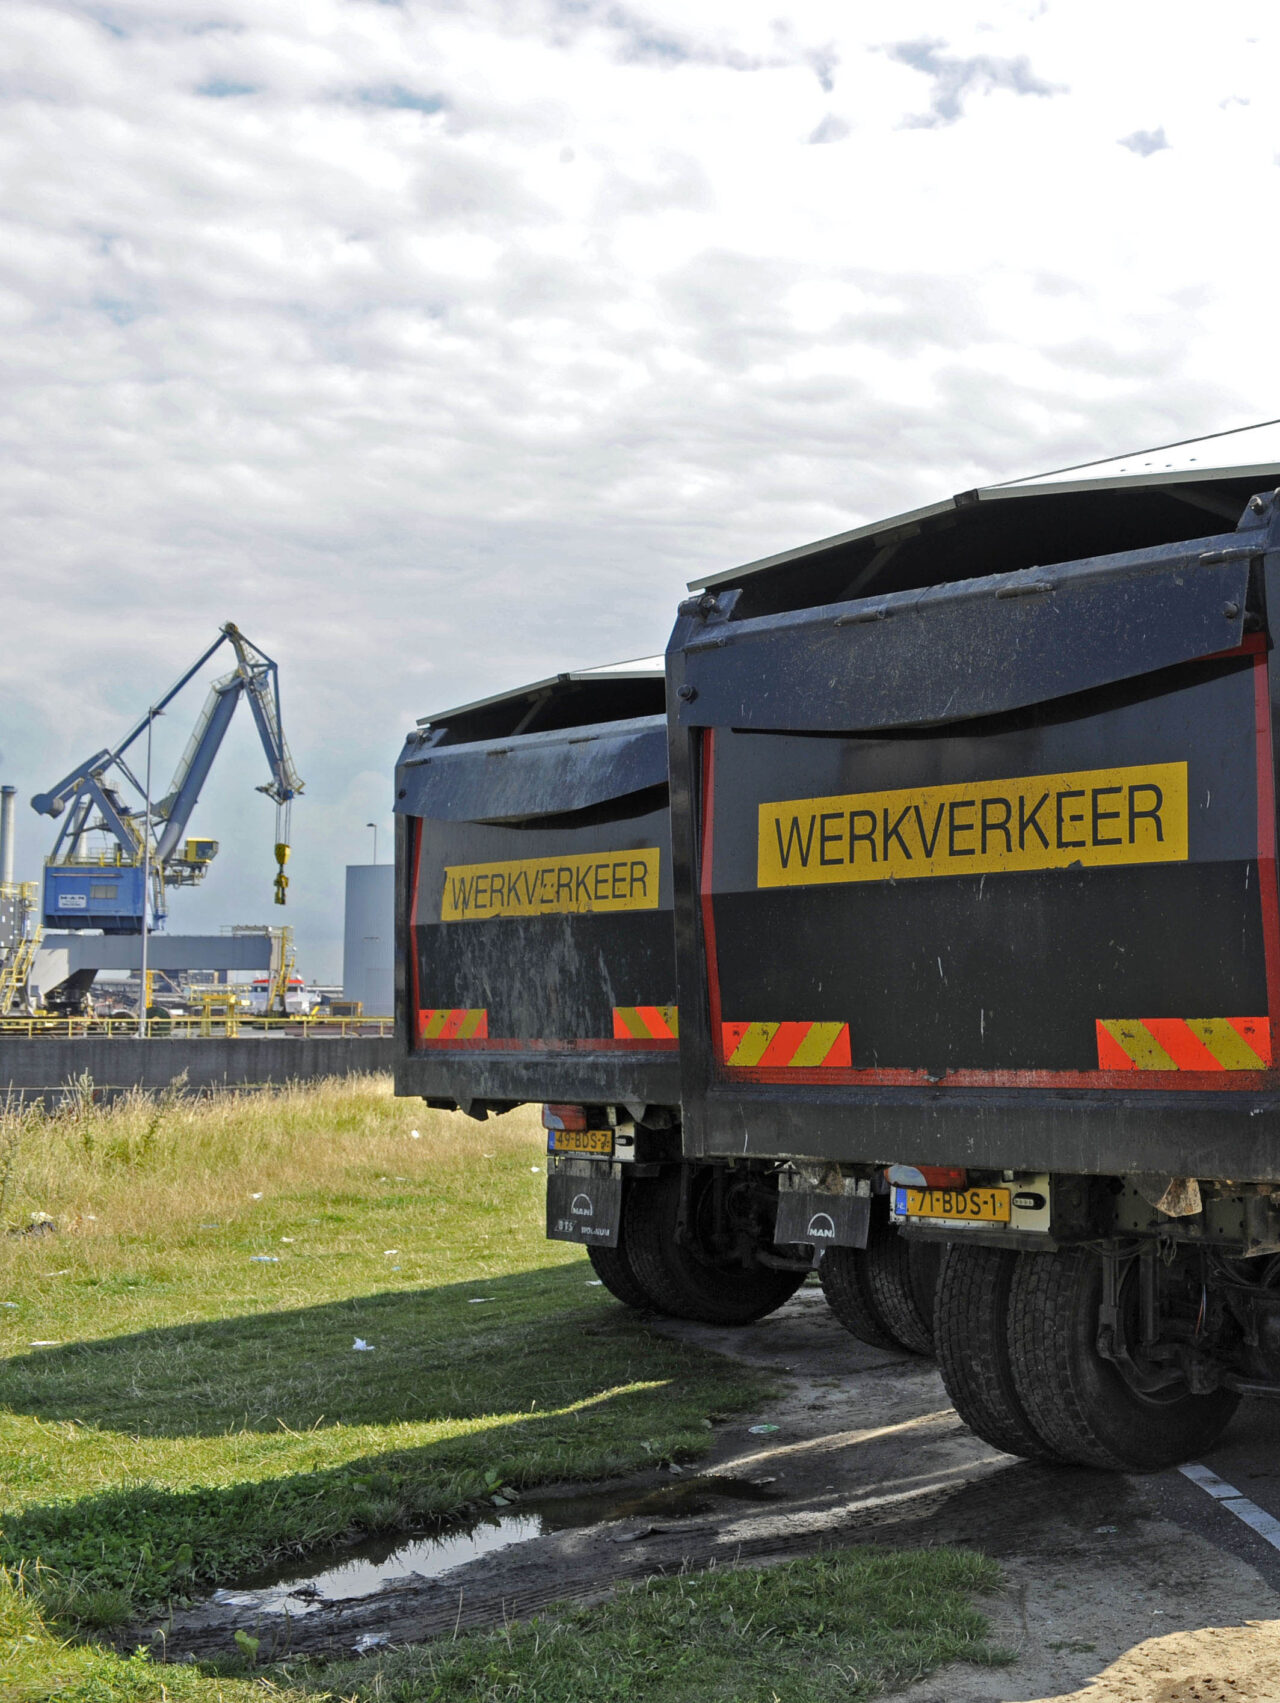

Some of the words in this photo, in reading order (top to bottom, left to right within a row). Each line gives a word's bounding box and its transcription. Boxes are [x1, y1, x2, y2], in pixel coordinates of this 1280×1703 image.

[775, 784, 1165, 869] WERKVERKEER
[452, 860, 648, 911] WERKVERKEER
[918, 1187, 997, 1216] 71-BDS-1
[809, 1228, 833, 1238] MAN
